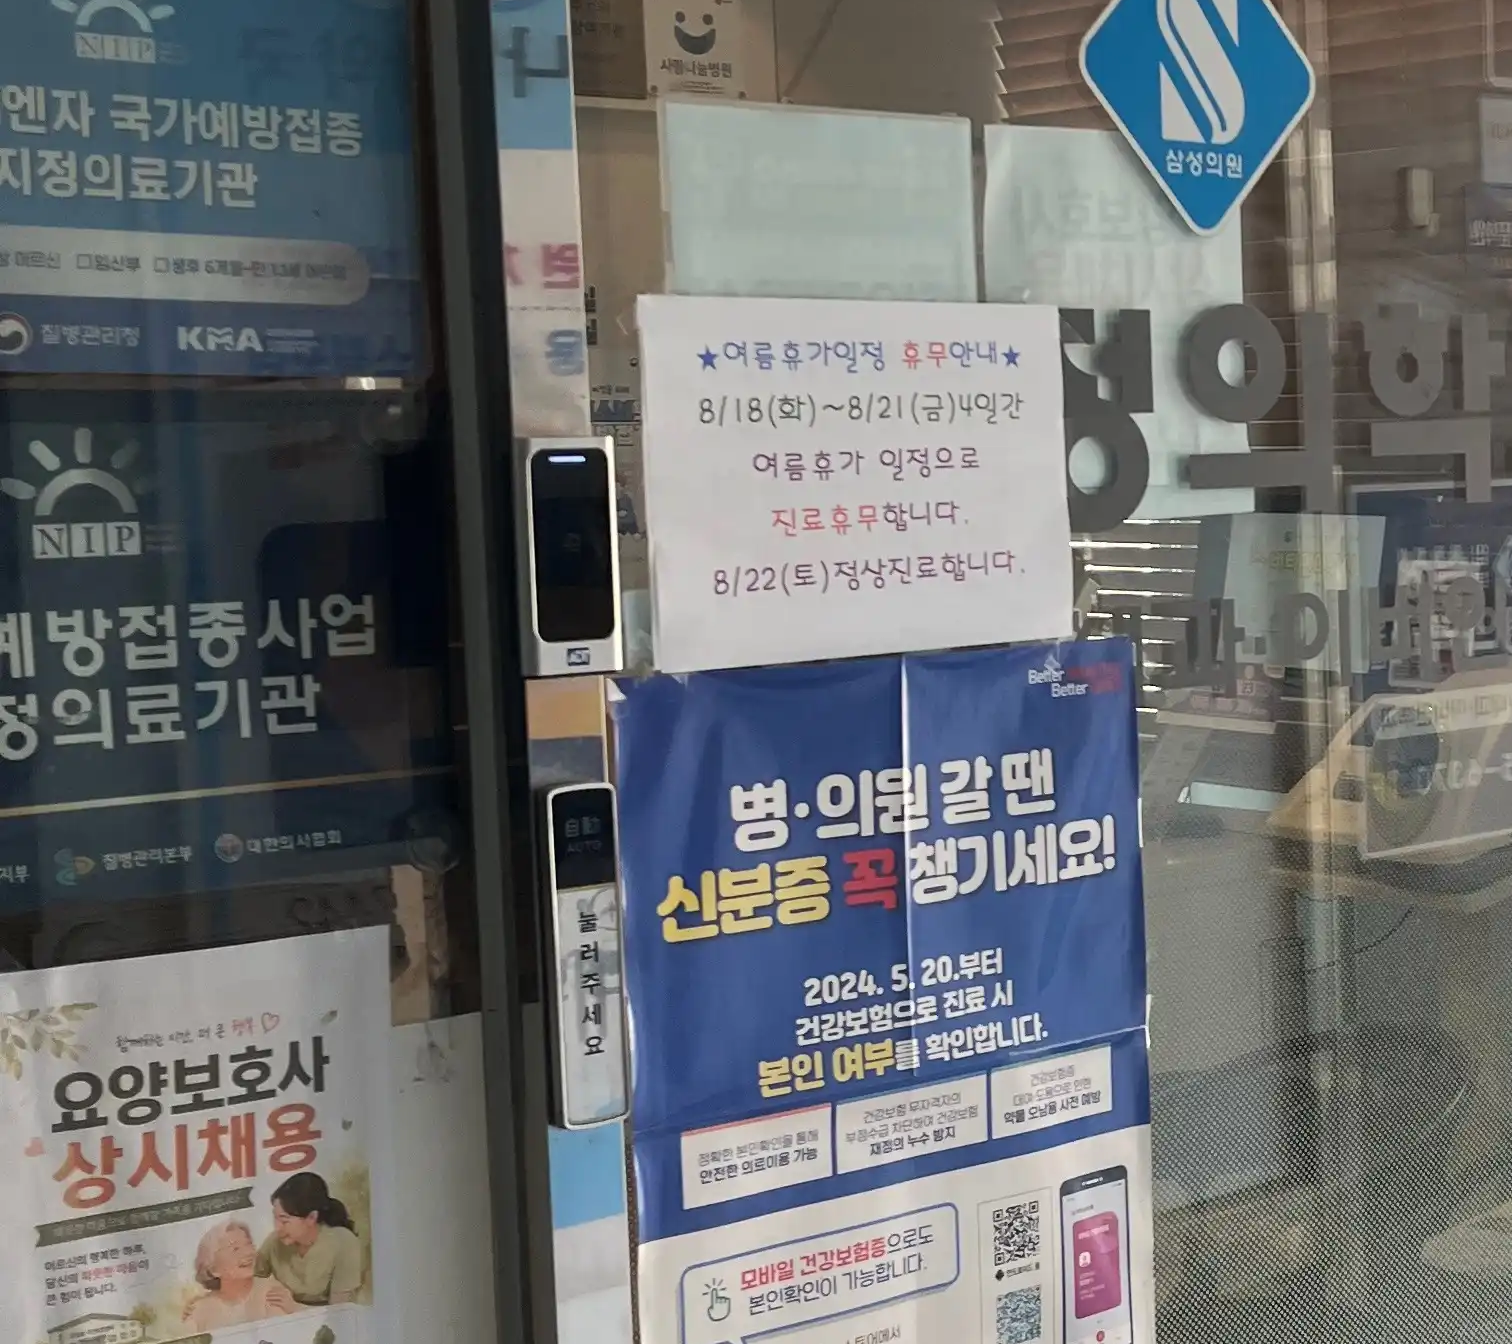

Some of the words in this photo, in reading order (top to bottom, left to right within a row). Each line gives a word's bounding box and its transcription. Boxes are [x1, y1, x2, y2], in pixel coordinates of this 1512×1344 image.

[0, 84, 96, 139] 엔자
[109, 92, 364, 158] 국가예방접종
[0, 146, 260, 208] 지정의료기관
[1164, 147, 1245, 180] 삼성의원
[40, 324, 141, 347] 질병관리청
[177, 325, 264, 352] KMA
[723, 340, 886, 373] 여름휴가일정
[902, 340, 999, 371] 휴무안내
[752, 452, 866, 482] 여름휴가
[879, 447, 982, 482] 일정으로
[33, 521, 142, 559] NIP
[771, 501, 971, 538] 진료휴무합니다.
[1051, 682, 1089, 698] Better
[729, 762, 931, 855] 병·의원
[939, 755, 993, 827] 갈
[1001, 746, 1058, 819] 땐
[655, 853, 832, 946] 신분증
[842, 846, 898, 913] 꼭
[908, 814, 1118, 907] 챙기세요!
[803, 971, 886, 1009] 2024.
[890, 961, 916, 993] 5.
[920, 947, 1005, 990] 20.부터
[794, 995, 940, 1049] 건강보험으로
[942, 985, 988, 1021] 진료
[991, 978, 1015, 1010] 시
[51, 1034, 331, 1134] 요양보호사
[758, 1053, 825, 1101] 본인
[831, 1035, 922, 1087] 여부를
[924, 1012, 1050, 1061] 확인합니다.
[52, 1102, 323, 1210] 상시채용
[699, 1162, 739, 1186] 안전한
[739, 1259, 795, 1292] 모바일
[799, 1224, 936, 1276] 건강보험증으로도
[748, 1280, 839, 1318] 본인확인이
[841, 1255, 928, 1296] 가능합니다.
